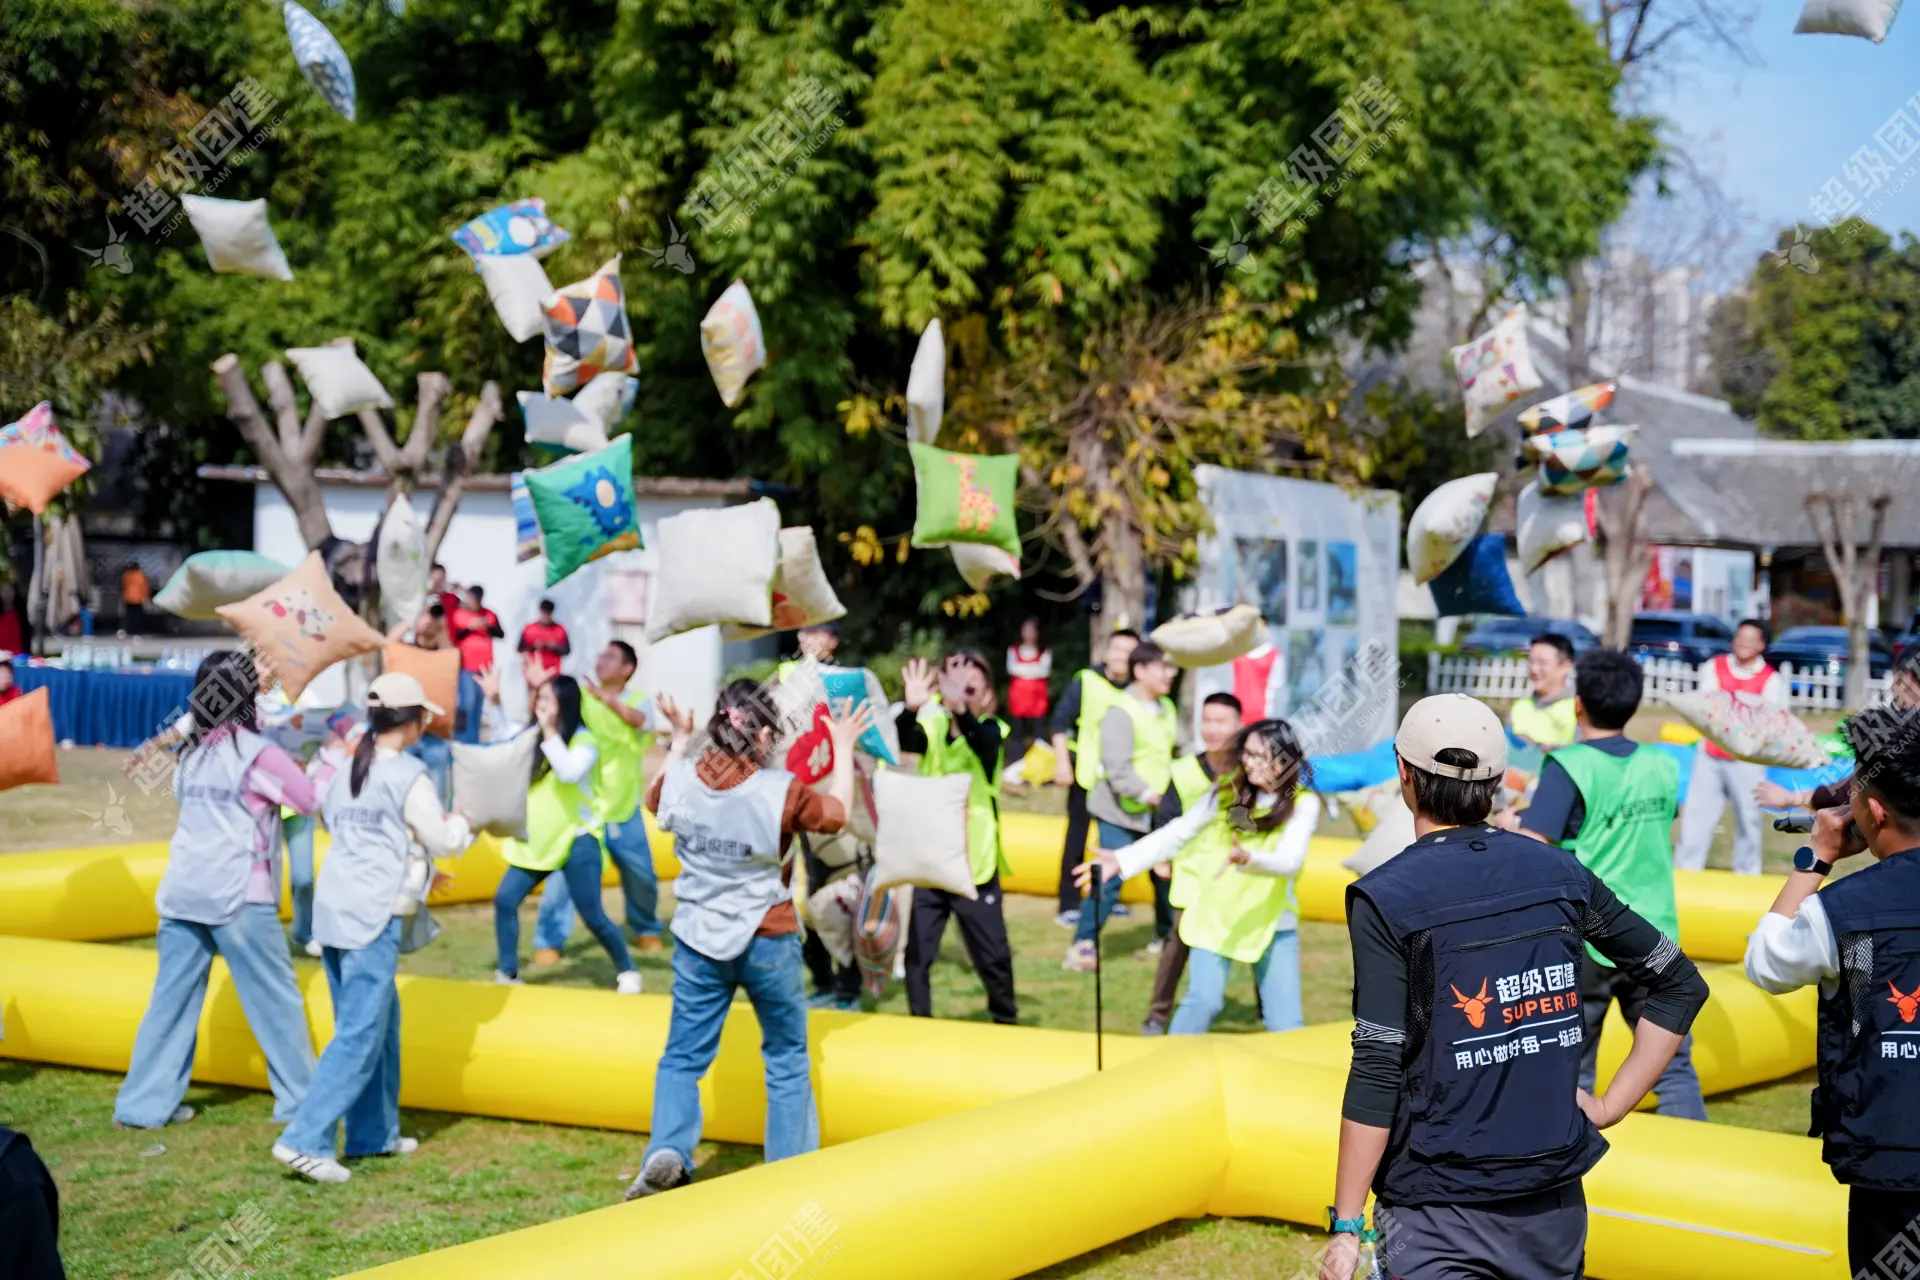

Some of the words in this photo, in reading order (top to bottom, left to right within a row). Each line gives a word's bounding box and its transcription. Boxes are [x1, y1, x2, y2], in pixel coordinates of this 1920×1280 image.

[1496, 962, 1575, 1003] 超级团建
[1455, 1026, 1582, 1070] 用心做好每一场活动
[1881, 1042, 1920, 1058] 用心
